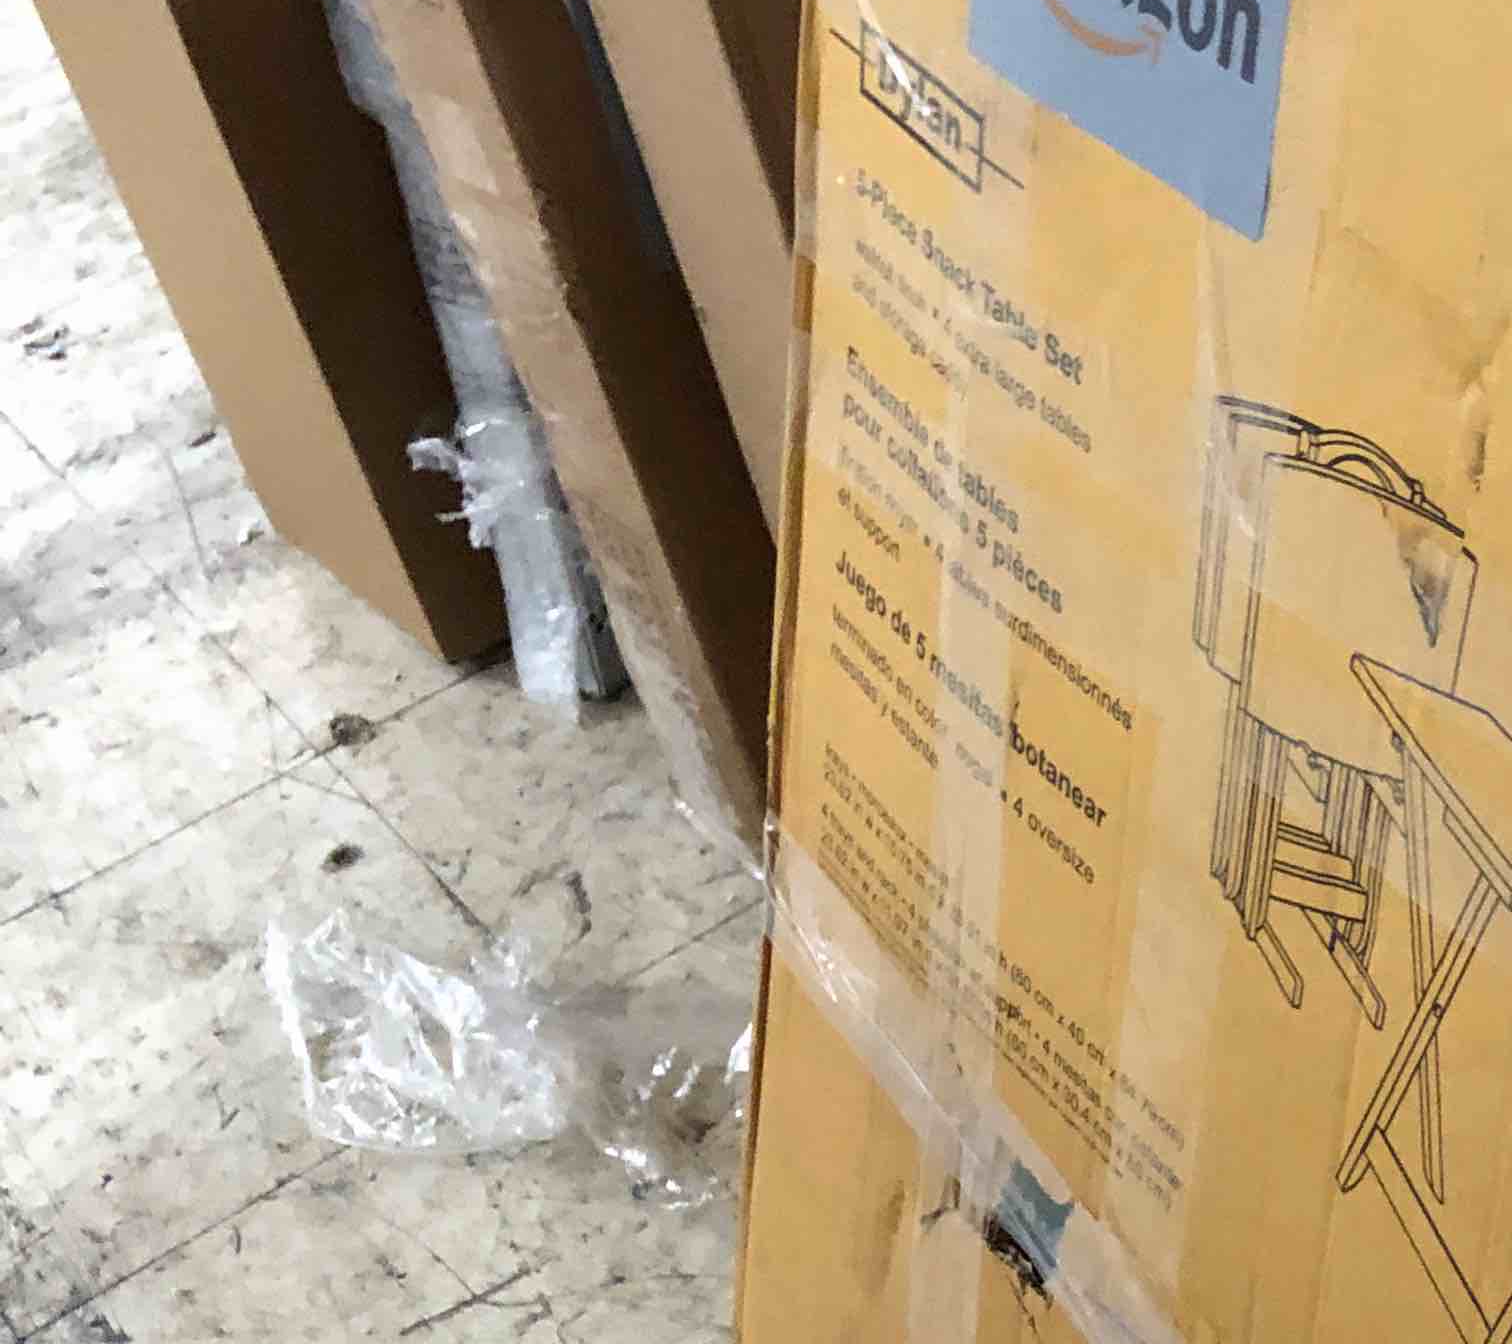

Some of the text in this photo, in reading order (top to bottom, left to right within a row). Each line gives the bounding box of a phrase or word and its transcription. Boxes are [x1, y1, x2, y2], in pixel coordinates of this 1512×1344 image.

[921, 228, 975, 296] Snack
[980, 280, 1039, 351] Table
[1044, 333, 1085, 386] Set
[843, 391, 883, 445] pour
[975, 519, 988, 549] 5
[836, 551, 887, 618] Juego
[890, 609, 912, 645] de
[915, 631, 927, 661] 5
[1028, 811, 1096, 885] oversize
